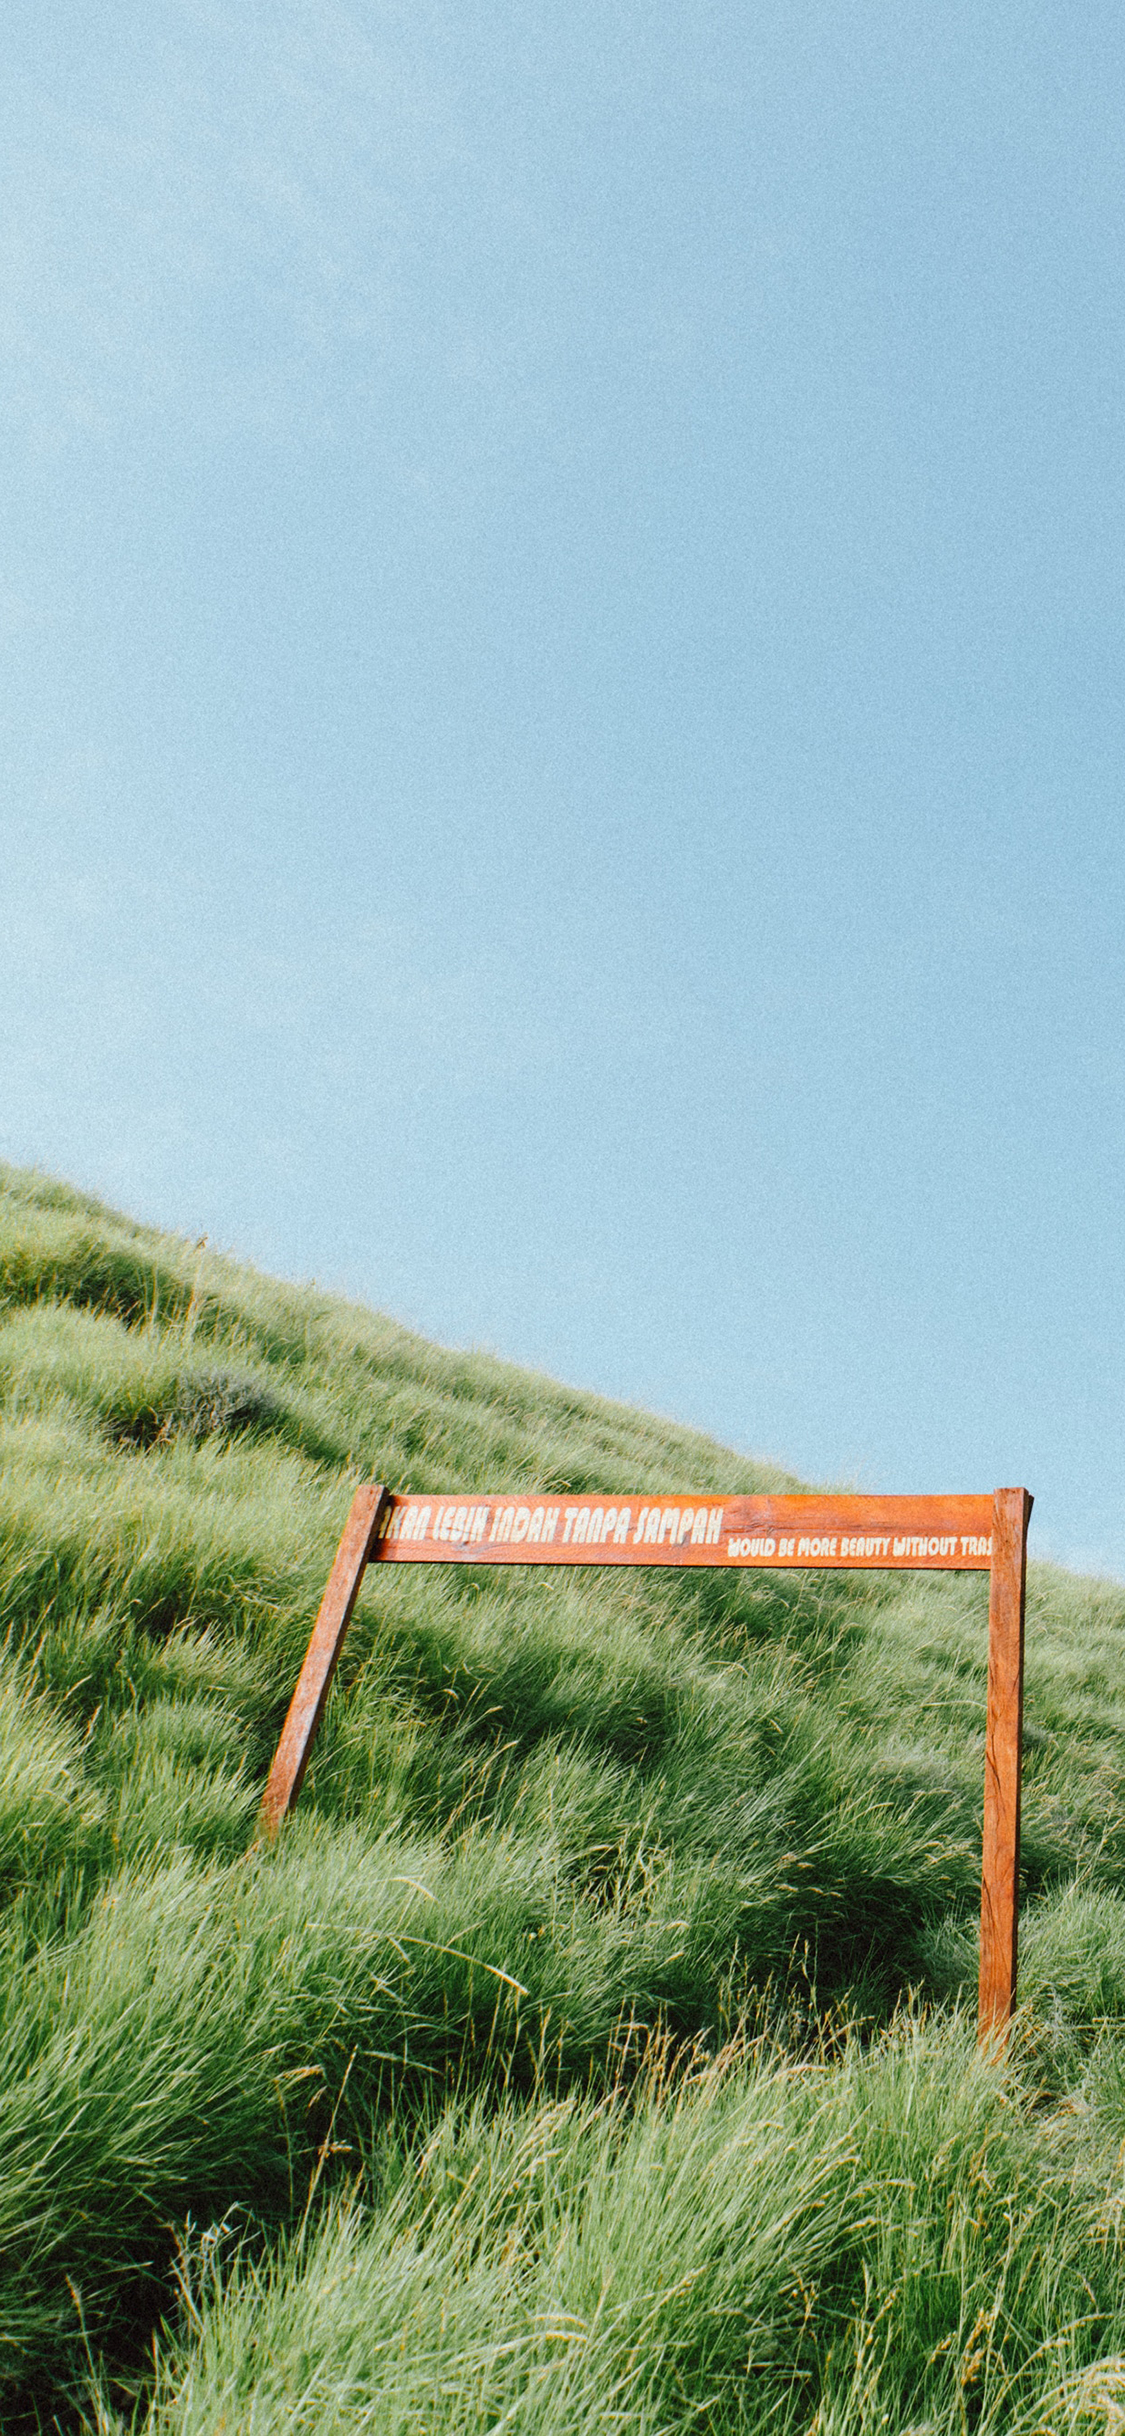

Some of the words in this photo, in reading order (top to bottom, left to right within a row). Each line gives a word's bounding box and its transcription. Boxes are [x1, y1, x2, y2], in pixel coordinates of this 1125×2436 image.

[434, 1505, 489, 1543] LEBIH
[489, 1506, 560, 1544] INDAH
[563, 1506, 631, 1544] TANPA
[633, 1507, 724, 1545] SAMPAH
[727, 1537, 776, 1557] WOULD
[778, 1537, 796, 1557] BE
[797, 1537, 838, 1557] MORE
[840, 1536, 891, 1556] BEAUTY
[893, 1536, 958, 1556] WITHOUT
